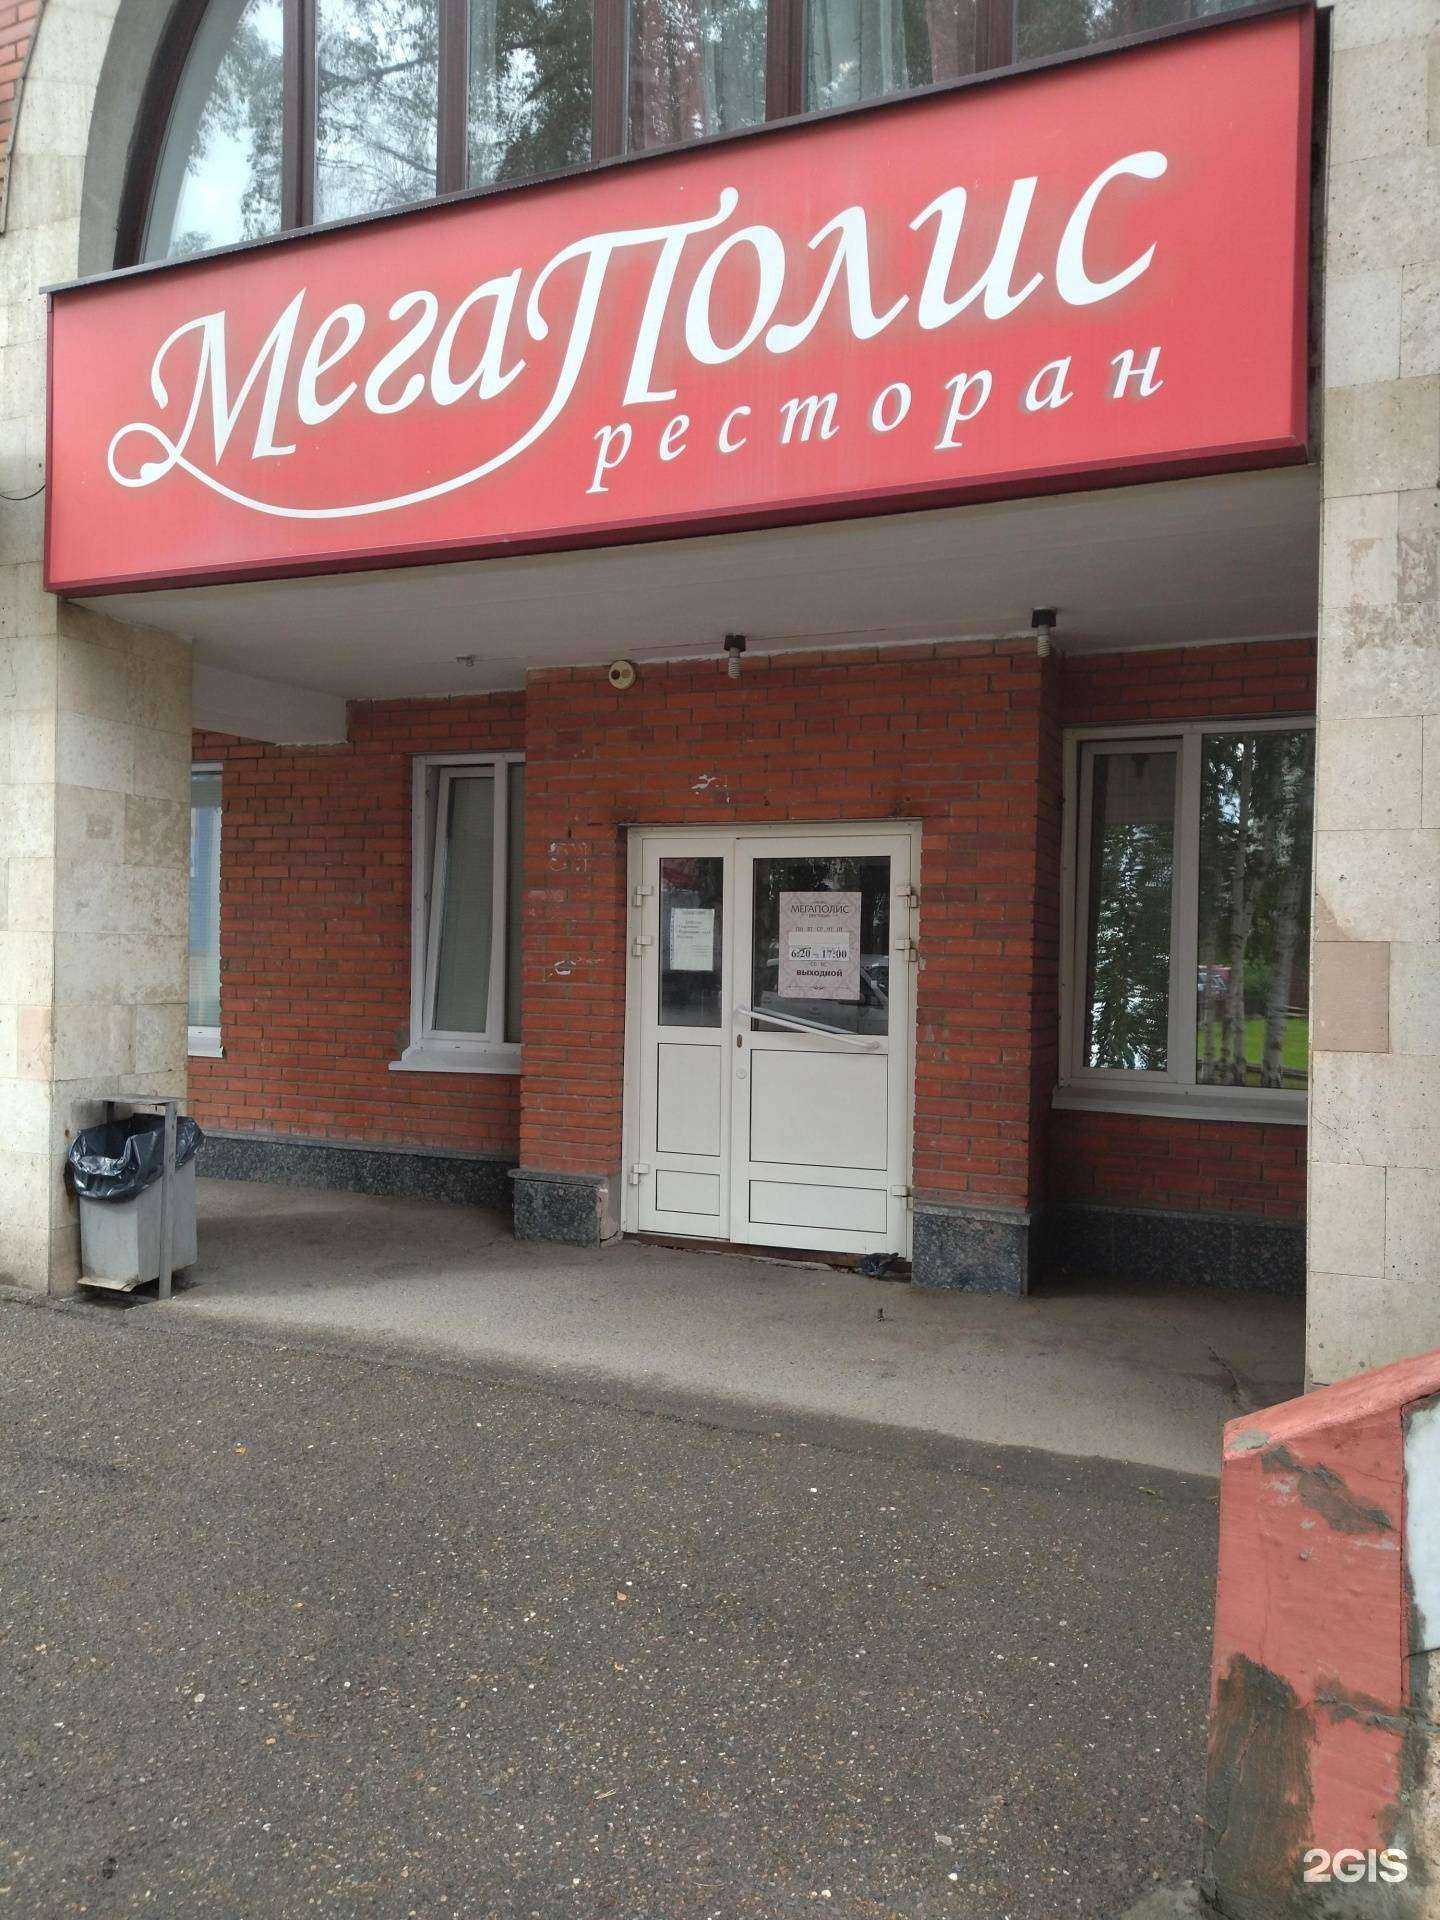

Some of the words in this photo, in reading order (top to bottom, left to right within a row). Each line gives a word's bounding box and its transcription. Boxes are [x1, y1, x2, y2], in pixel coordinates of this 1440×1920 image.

[104, 151, 1168, 518] МегаПолис
[586, 346, 1164, 494] ресторан
[790, 904, 849, 914] МЕГАПОЛИС
[822, 949, 847, 958] 17:00
